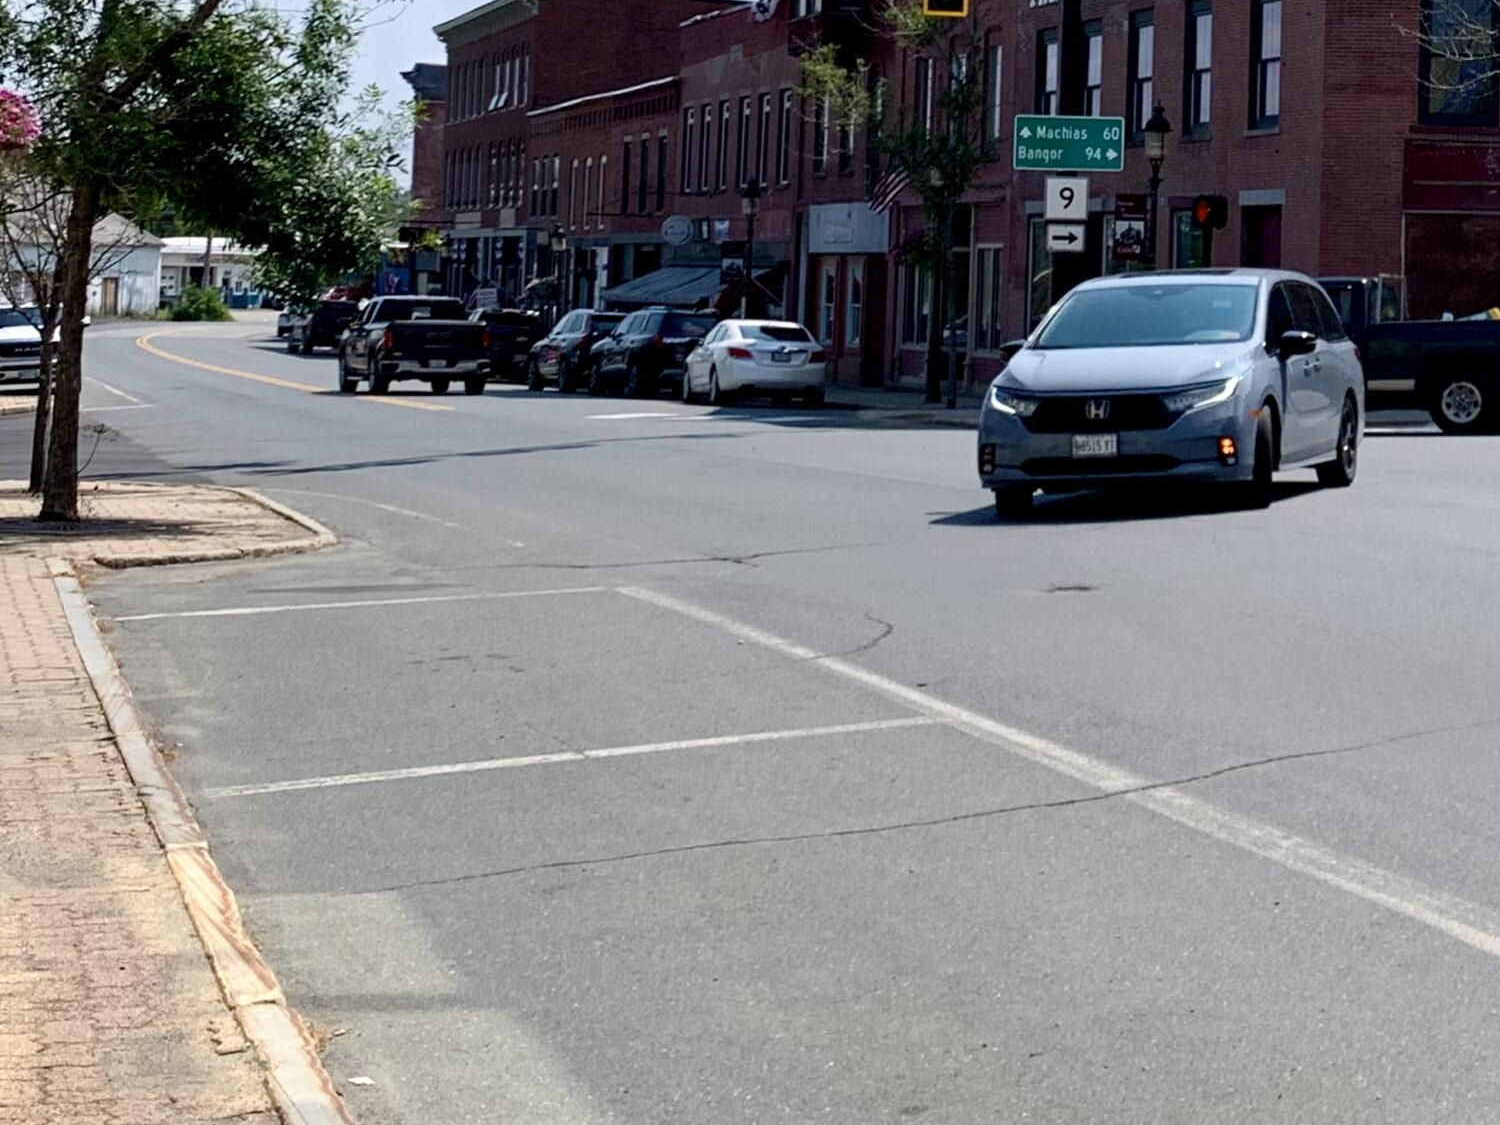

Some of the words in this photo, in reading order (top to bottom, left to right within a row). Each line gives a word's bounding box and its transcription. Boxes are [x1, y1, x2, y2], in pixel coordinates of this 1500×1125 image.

[1036, 125, 1088, 141] Machias
[1102, 126, 1121, 142] 60
[1017, 146, 1065, 164] Bangor
[1084, 146, 1102, 162] 94
[1058, 186, 1075, 210] 9
